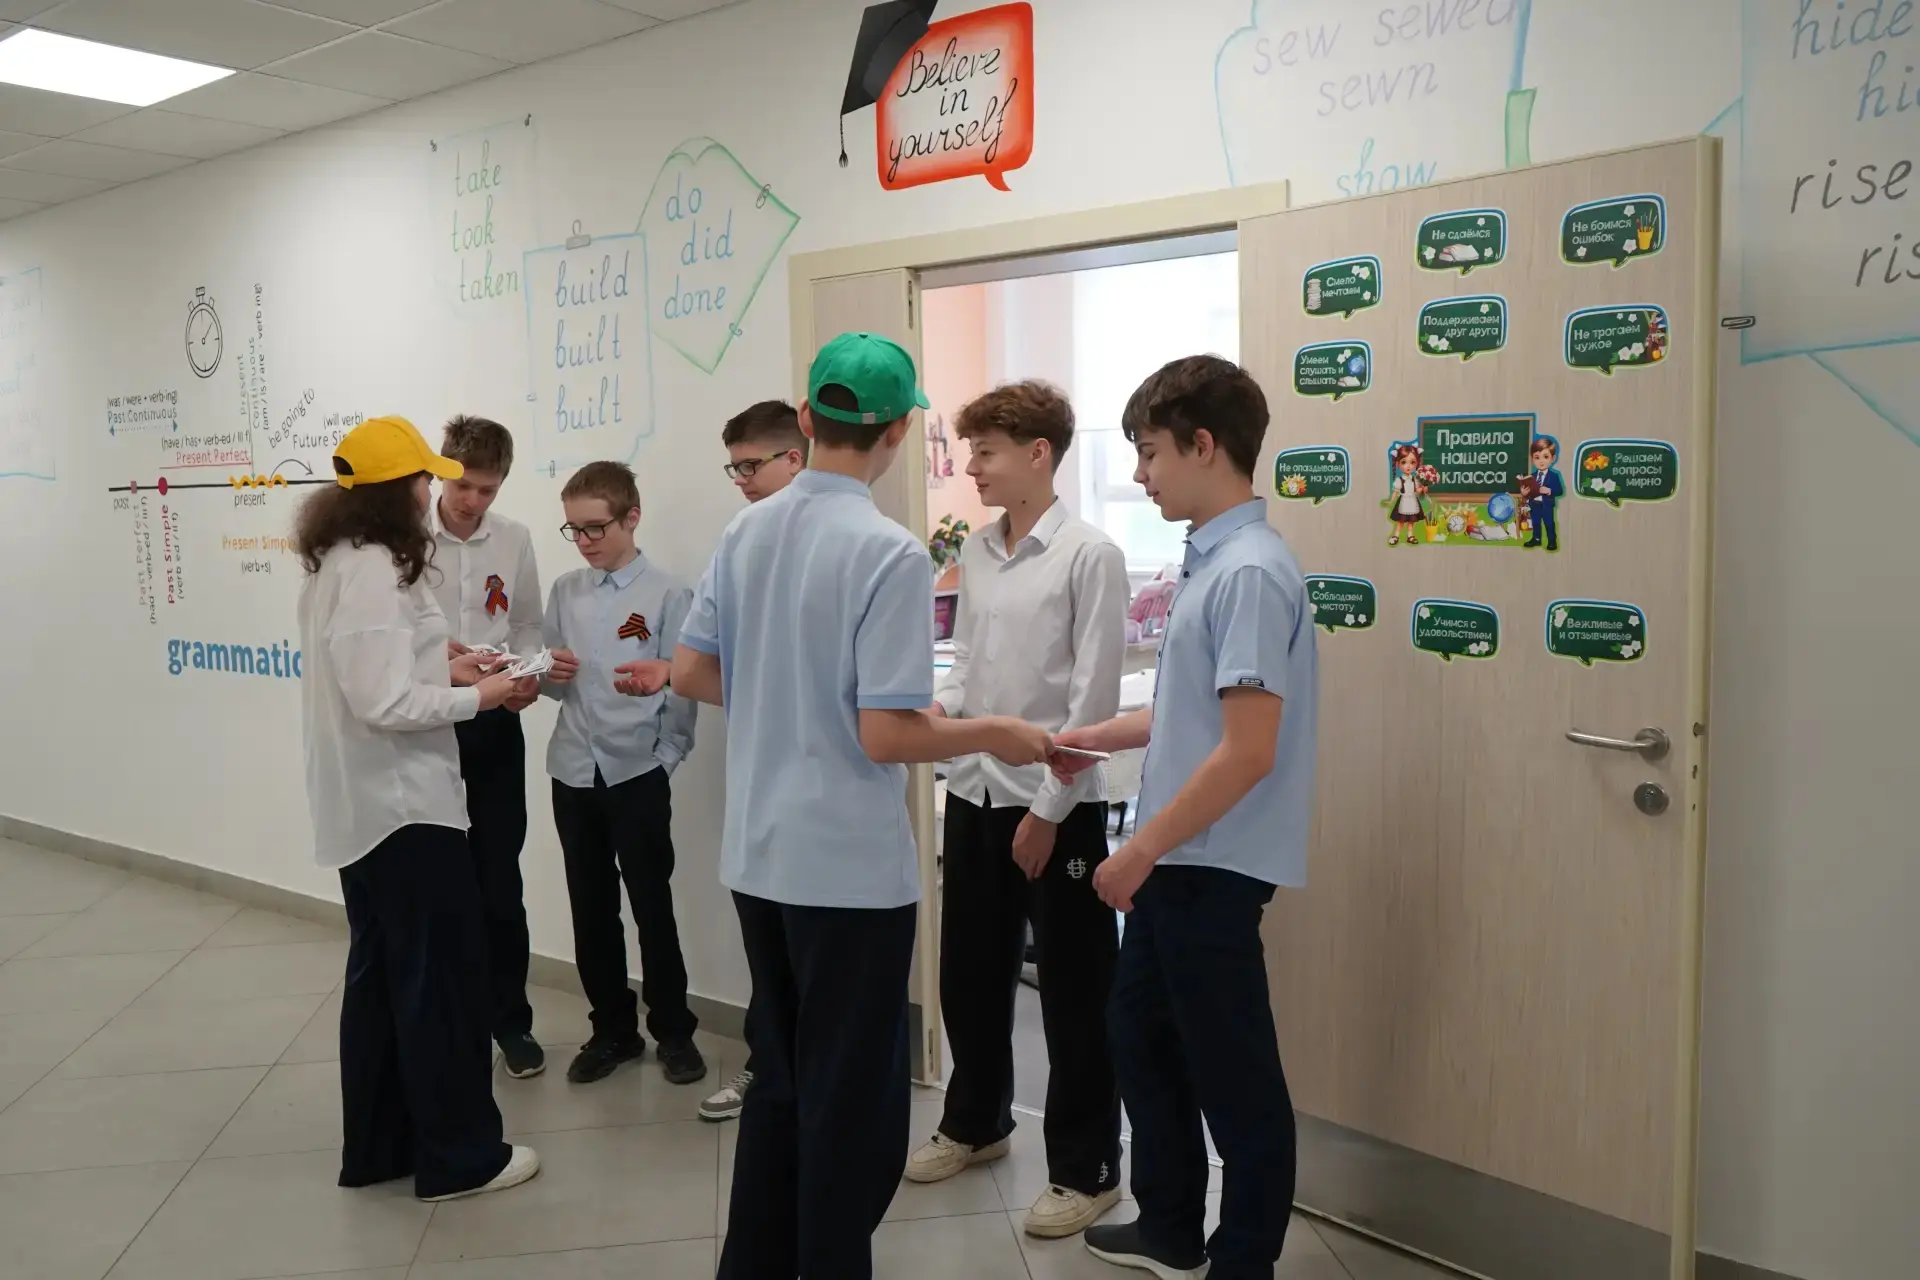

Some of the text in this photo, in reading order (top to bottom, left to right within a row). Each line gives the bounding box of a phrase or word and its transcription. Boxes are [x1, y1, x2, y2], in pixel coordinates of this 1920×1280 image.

[1253, 22, 1340, 75] sew
[896, 36, 1000, 97] Believe
[1317, 62, 1439, 116] sewn
[1856, 50, 1920, 121] hi
[939, 88, 968, 116] in
[887, 78, 1018, 182] yourself
[454, 140, 501, 197] take
[1790, 159, 1912, 214] rise
[666, 172, 701, 221] do
[451, 195, 495, 252] took
[1572, 219, 1632, 232] Не боимся
[681, 208, 733, 265] did
[1432, 228, 1490, 240] Не сдаёмся
[1572, 232, 1614, 244] ошибок
[460, 250, 518, 302] taken
[555, 250, 629, 307] build
[1326, 276, 1356, 287] Смело
[664, 274, 726, 319] done
[1322, 286, 1360, 298] мечтаем
[1423, 316, 1499, 327] Поддерживаем
[1444, 327, 1499, 338] друг друга
[1574, 325, 1640, 340] Не трогаем
[555, 313, 621, 369] built
[1574, 340, 1612, 352] чужое
[1300, 355, 1329, 365] Умеем
[1300, 367, 1337, 376] слушать
[1299, 377, 1337, 386] слышать
[556, 373, 622, 433] built
[292, 432, 330, 449] Future
[1437, 429, 1514, 449] Правила
[176, 448, 250, 465] Present Perfect
[1441, 451, 1508, 465] нашего
[1615, 452, 1662, 463] Решаем
[1279, 463, 1345, 473] Не опаздываем
[1612, 466, 1662, 477] вопросы
[1323, 475, 1344, 484] урок
[1441, 471, 1507, 484] класса
[1626, 477, 1662, 488] мирно
[234, 491, 266, 508] present
[161, 505, 172, 562] Simple
[1312, 591, 1363, 602] Соблюдаем
[1320, 603, 1355, 613] чистоту
[1433, 616, 1468, 628] Учимся
[1567, 617, 1623, 629] Вежливые
[1419, 628, 1492, 640] удовольствием
[1559, 631, 1632, 641] и отзывчивые
